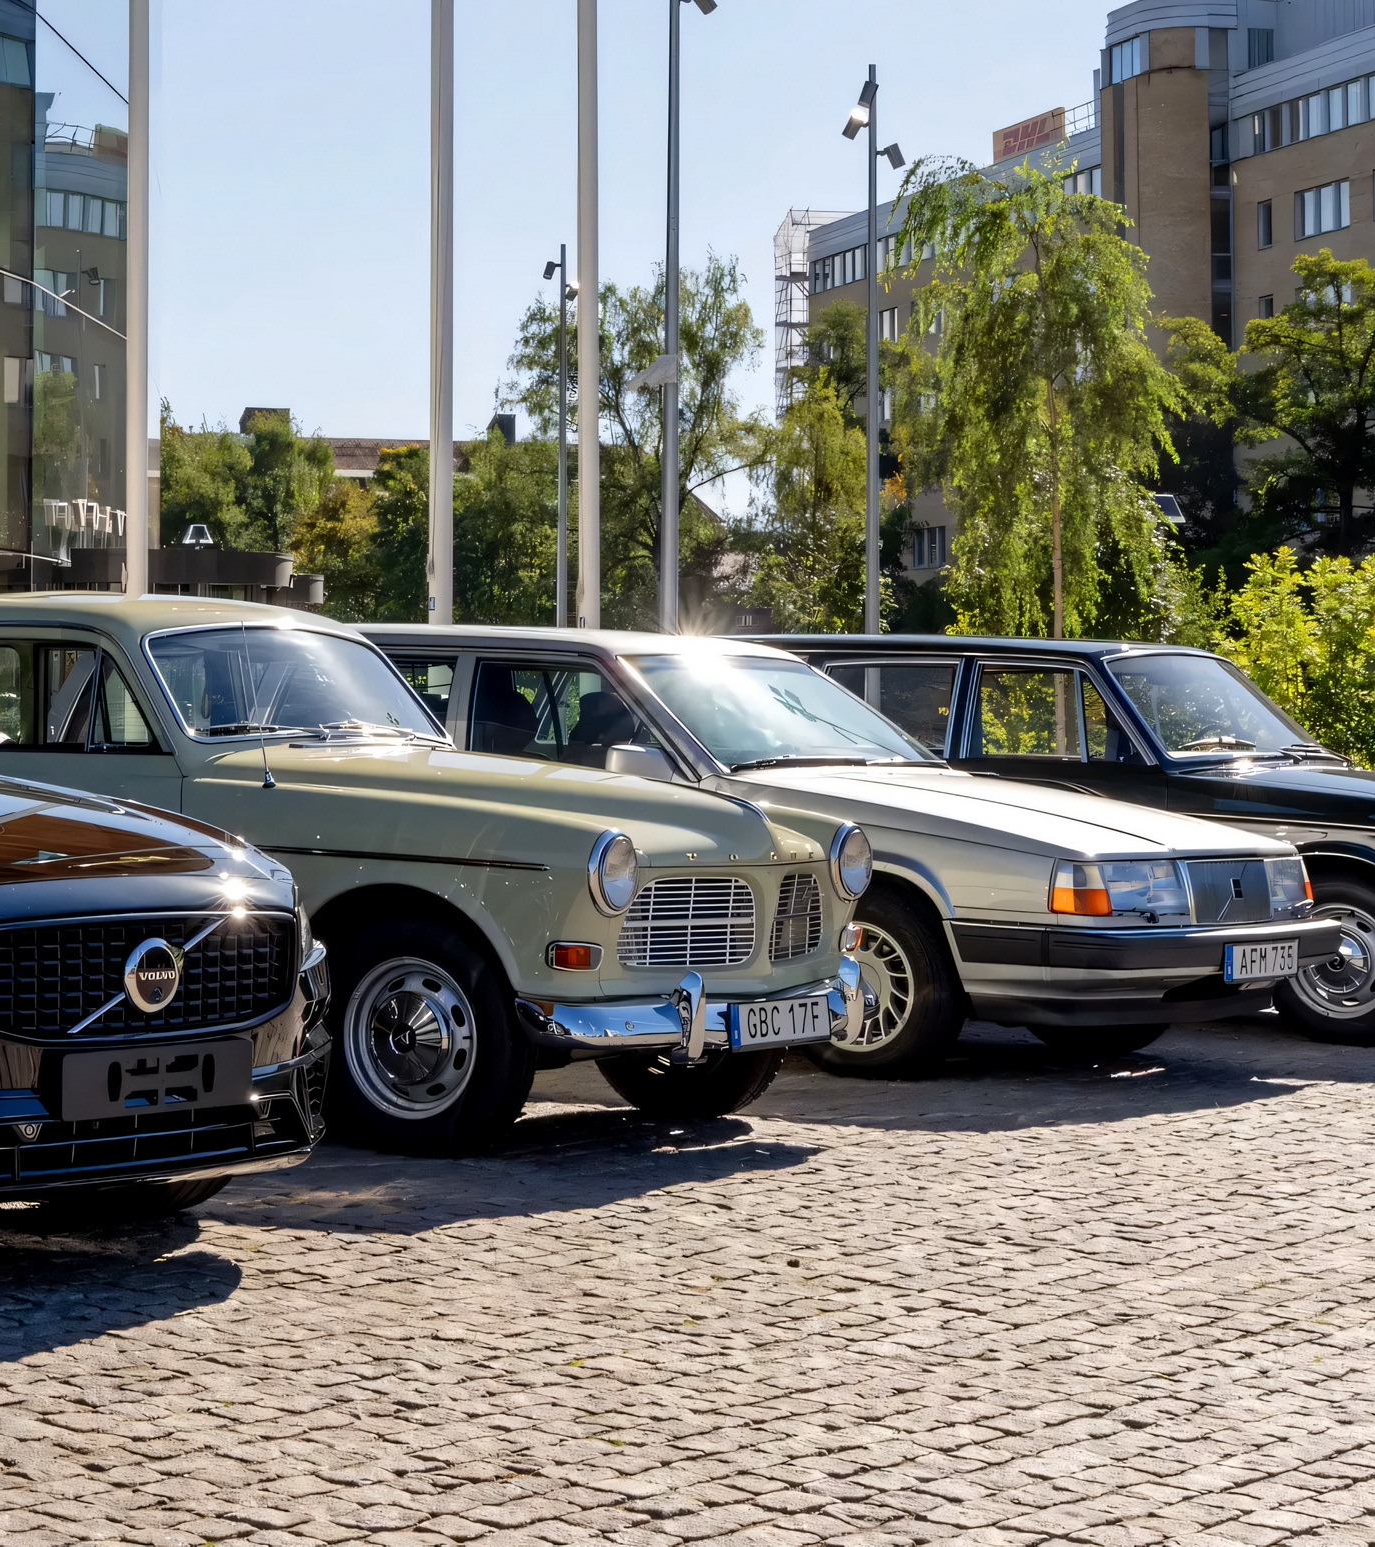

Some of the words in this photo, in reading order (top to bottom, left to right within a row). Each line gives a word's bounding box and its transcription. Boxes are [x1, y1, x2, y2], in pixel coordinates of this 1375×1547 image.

[1002, 118, 1050, 156] DHL
[138, 970, 175, 981] VOLVO
[1240, 947, 1267, 975] AFM
[1271, 945, 1293, 972] 735
[747, 1005, 781, 1038] GBC
[788, 1002, 819, 1034] 17F
